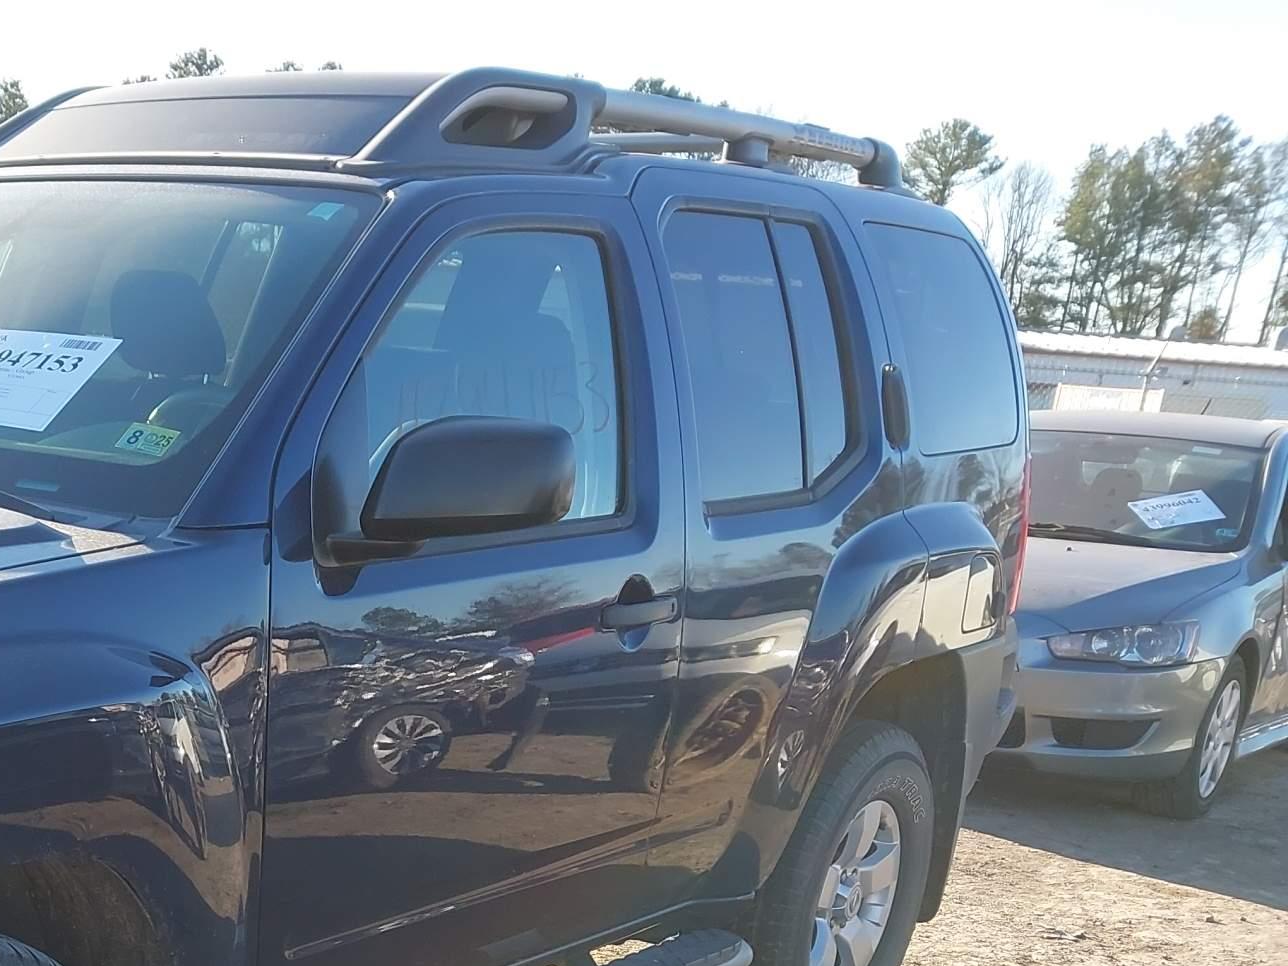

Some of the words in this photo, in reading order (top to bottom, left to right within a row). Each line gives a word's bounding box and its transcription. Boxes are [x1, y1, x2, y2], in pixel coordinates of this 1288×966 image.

[126, 430, 145, 445] 8
[154, 434, 174, 448] 25
[899, 776, 926, 824] TRAC
